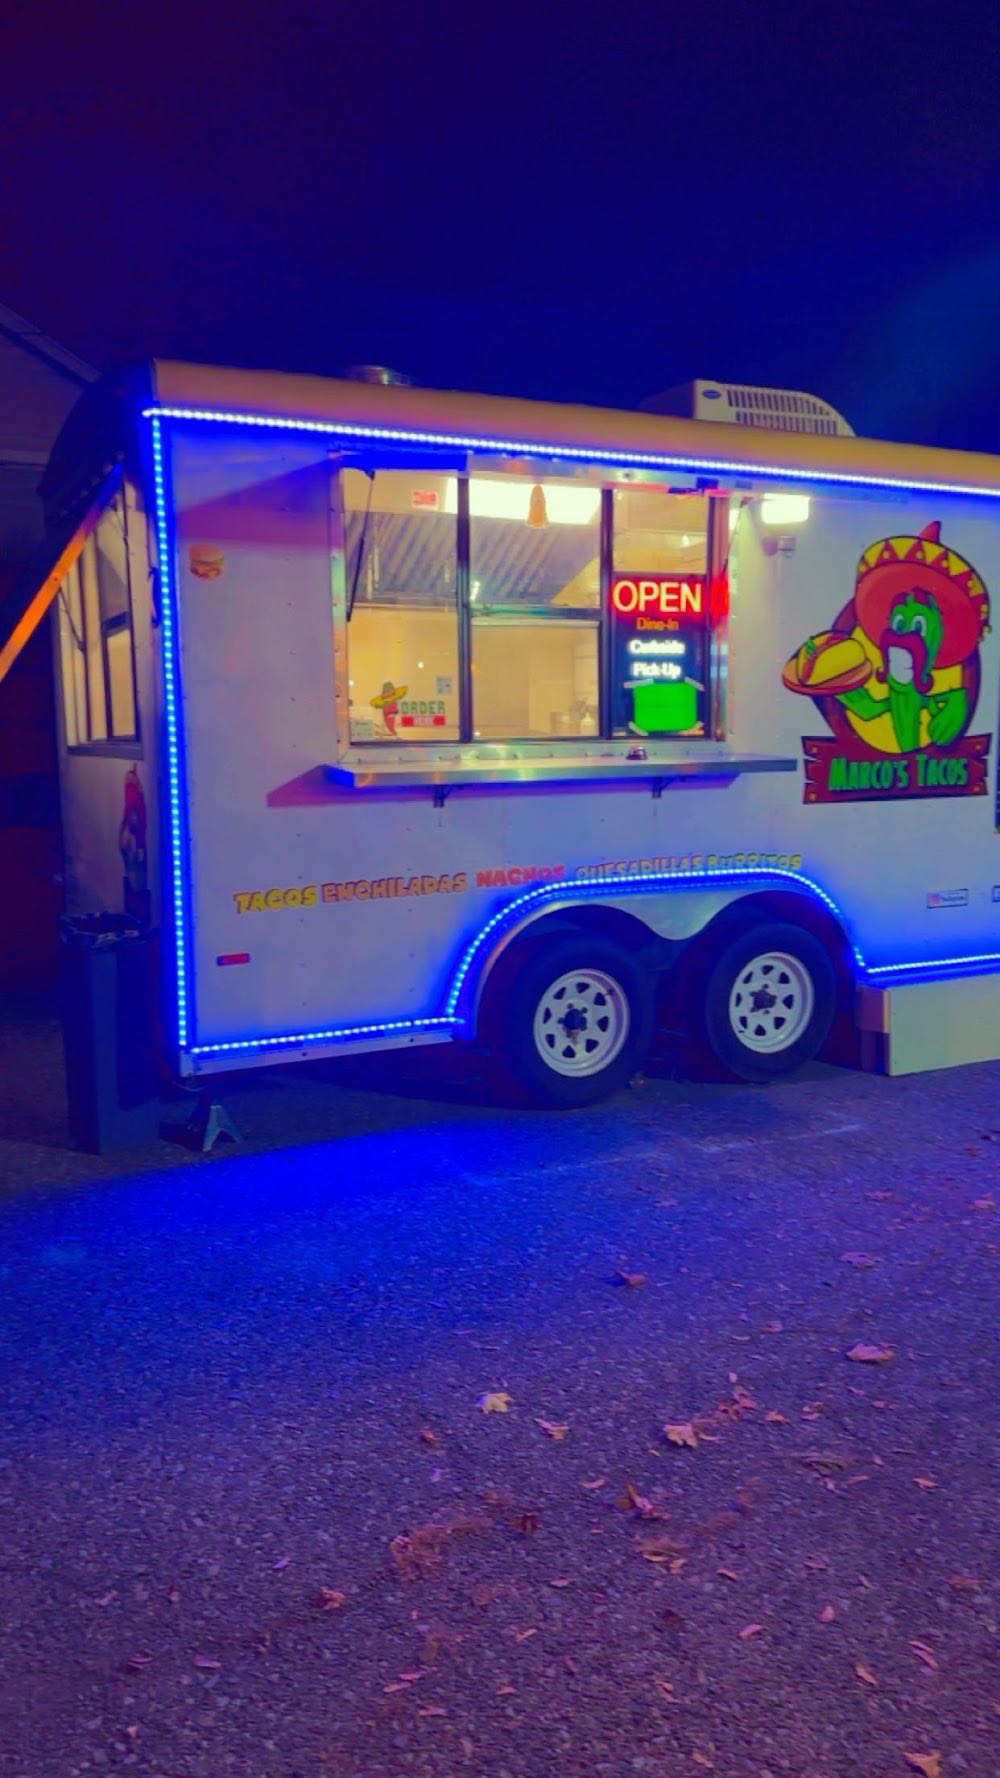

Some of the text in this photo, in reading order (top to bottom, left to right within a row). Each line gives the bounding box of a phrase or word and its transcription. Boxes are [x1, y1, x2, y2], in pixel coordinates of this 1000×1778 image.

[613, 580, 702, 613] OPEN
[401, 700, 446, 715] ORDER
[916, 754, 969, 787] TACOS
[233, 885, 317, 914] TACOS
[321, 872, 467, 903] ENCHILADAS
[475, 864, 566, 888] NACHOS
